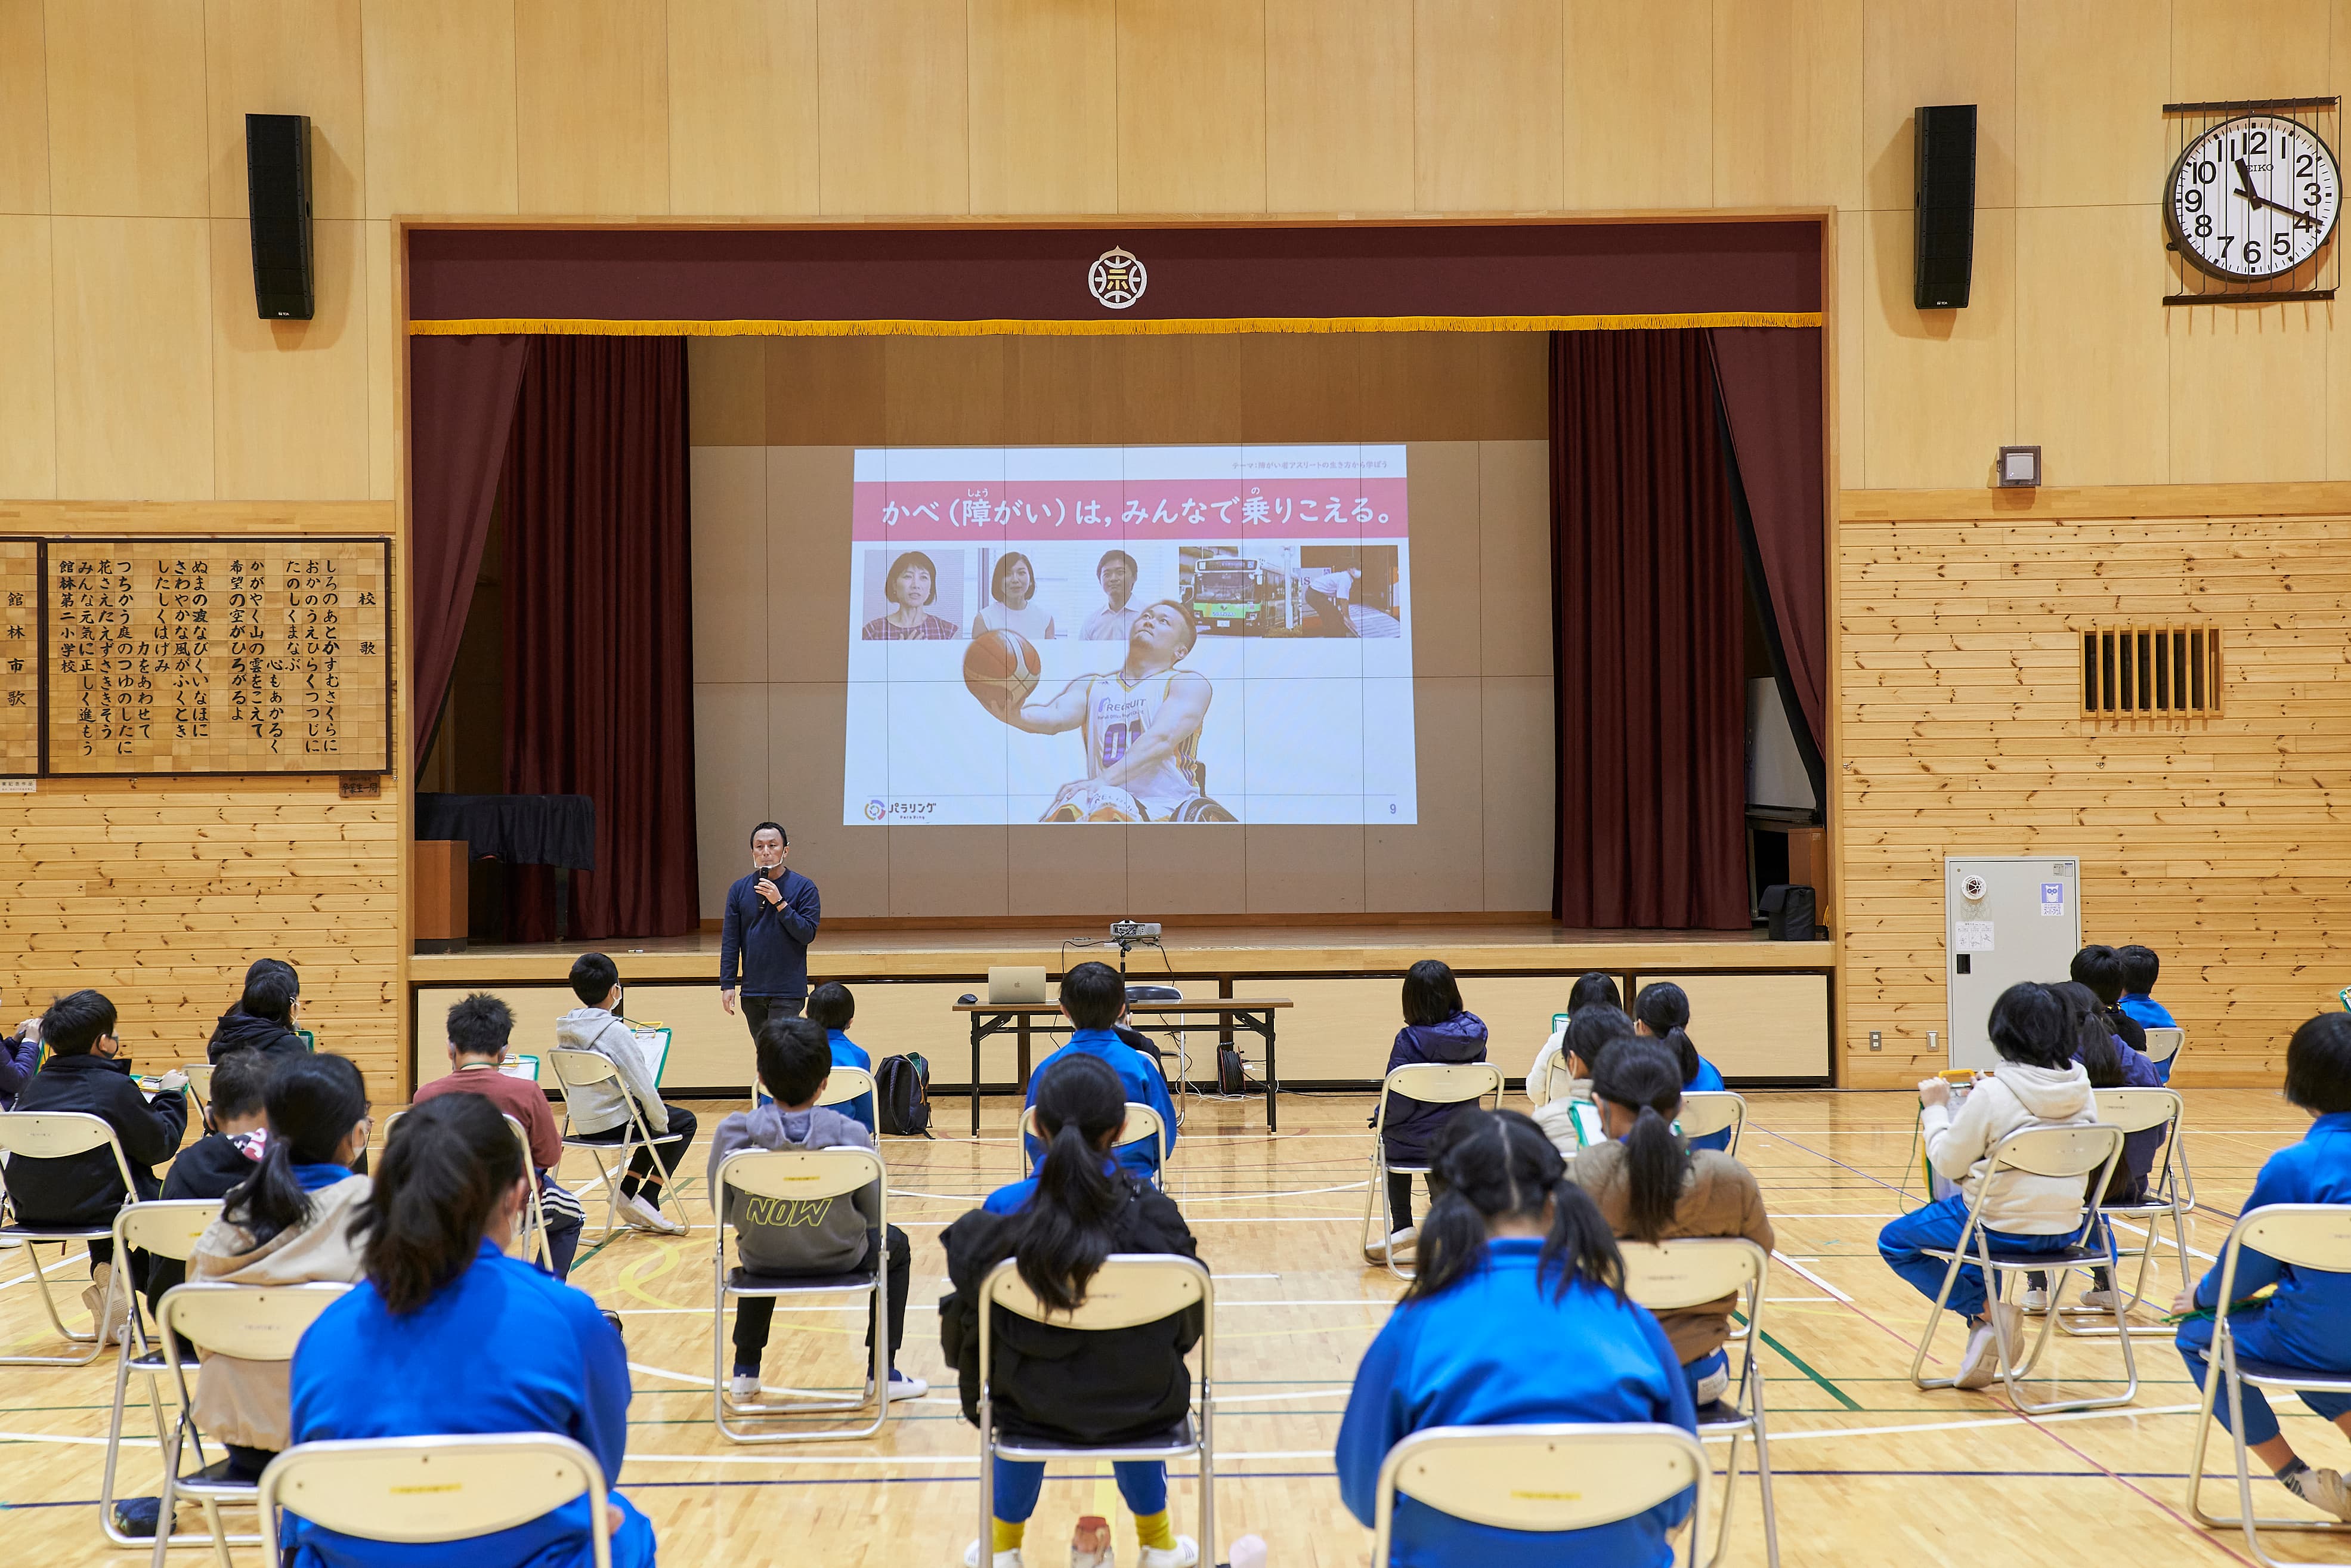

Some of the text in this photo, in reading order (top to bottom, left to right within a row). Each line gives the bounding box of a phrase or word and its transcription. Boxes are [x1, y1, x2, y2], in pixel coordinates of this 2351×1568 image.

[2218, 139, 2235, 162] 11
[2243, 132, 2267, 155] 12
[2281, 136, 2286, 159] 1
[2192, 160, 2217, 184] 10
[2296, 154, 2313, 178] 2
[2185, 189, 2202, 212] 9
[2303, 183, 2322, 206] 3
[2195, 214, 2213, 238] 8
[2294, 211, 2313, 233] 4
[2217, 236, 2235, 258] 7
[2243, 240, 2262, 264] 6
[2272, 233, 2291, 255] 5
[968, 488, 989, 497] しょう
[1251, 487, 1260, 495] の
[59, 560, 77, 673] 館林第二小学校
[154, 560, 171, 672] したしくはげみ
[285, 560, 301, 672] たのしくまなぶ
[358, 592, 376, 655] 校歌
[7, 592, 26, 705] 館林市歌
[97, 559, 115, 740] 花さえたえずさききそう
[174, 560, 191, 738] さわやかな風がふくとき
[191, 561, 209, 737] ぬまの波なびくいなほに
[229, 559, 247, 720] 希望の空がひろがるよ
[249, 561, 265, 738] かがやく山の雲をこえて
[78, 561, 97, 756] みんな元気に正しく進もう
[117, 562, 134, 754] つちかう庭のつゆのしたに
[305, 559, 320, 753] おかのうえひらくつつじに
[320, 559, 341, 755] しろのあとかすむさくらに
[137, 641, 153, 738] 力をあわせて
[267, 660, 284, 754] 心もあかるく
[889, 802, 936, 814] パラリング
[1390, 803, 1396, 814] 9
[746, 1198, 833, 1227] NOW
